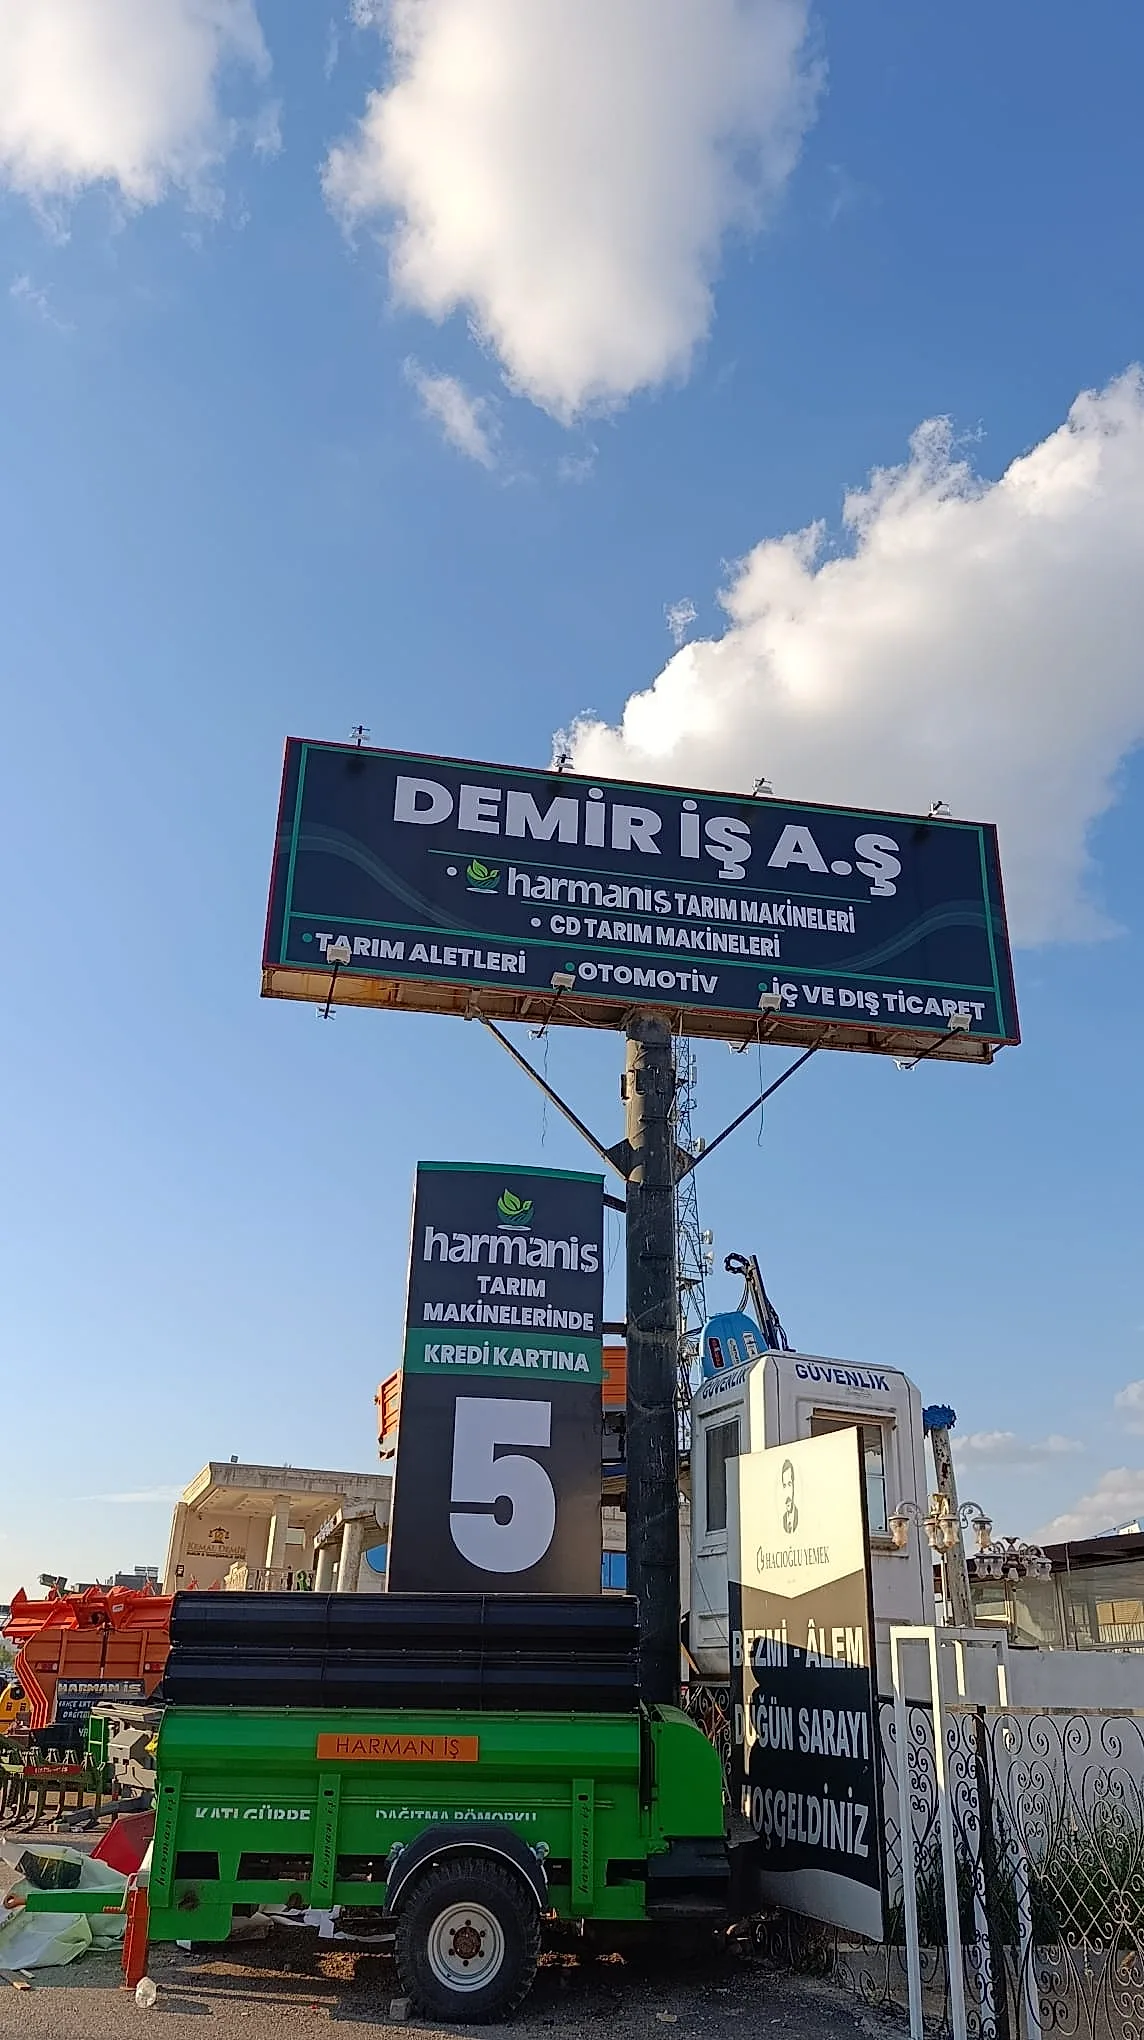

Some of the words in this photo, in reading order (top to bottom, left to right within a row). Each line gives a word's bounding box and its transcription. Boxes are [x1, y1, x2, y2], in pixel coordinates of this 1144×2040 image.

[393, 774, 663, 854] DEMİR
[680, 800, 752, 880] İŞ
[767, 824, 902, 896] A.Ş
[674, 893, 737, 922] TARIM
[740, 899, 855, 934] MAKİNELERİ
[315, 932, 405, 961] TARIM
[408, 942, 526, 974] ALETLERİ
[550, 914, 581, 936] CD
[583, 918, 652, 944] TARIM
[656, 926, 780, 958] MAKİNELERİ
[578, 961, 718, 995] OTOMOTİV
[772, 976, 798, 1007] İÇ
[802, 984, 835, 1006] VE
[839, 989, 880, 1016] DIŞ
[882, 989, 985, 1021] TİCARET
[477, 1275, 546, 1298] TARIM
[423, 1299, 595, 1332] MAKİNELERİNDE
[423, 1340, 490, 1366] KREDİ
[493, 1346, 591, 1373] KARTINA
[795, 1363, 890, 1392] GÜVENLİK
[448, 1396, 557, 1573] 5
[803, 1545, 831, 1566] YEMEK
[732, 1619, 788, 1667] BEZMİ
[804, 1618, 865, 1669] ÂLEM
[57, 1683, 120, 1694] HARMAN
[335, 1735, 436, 1756] HARMAN
[443, 1736, 460, 1759] İŞ
[734, 1694, 794, 1751] DÜĞÜN
[798, 1707, 869, 1760] SARAYI
[740, 1782, 869, 1858] HOŞGELDİNİZ
